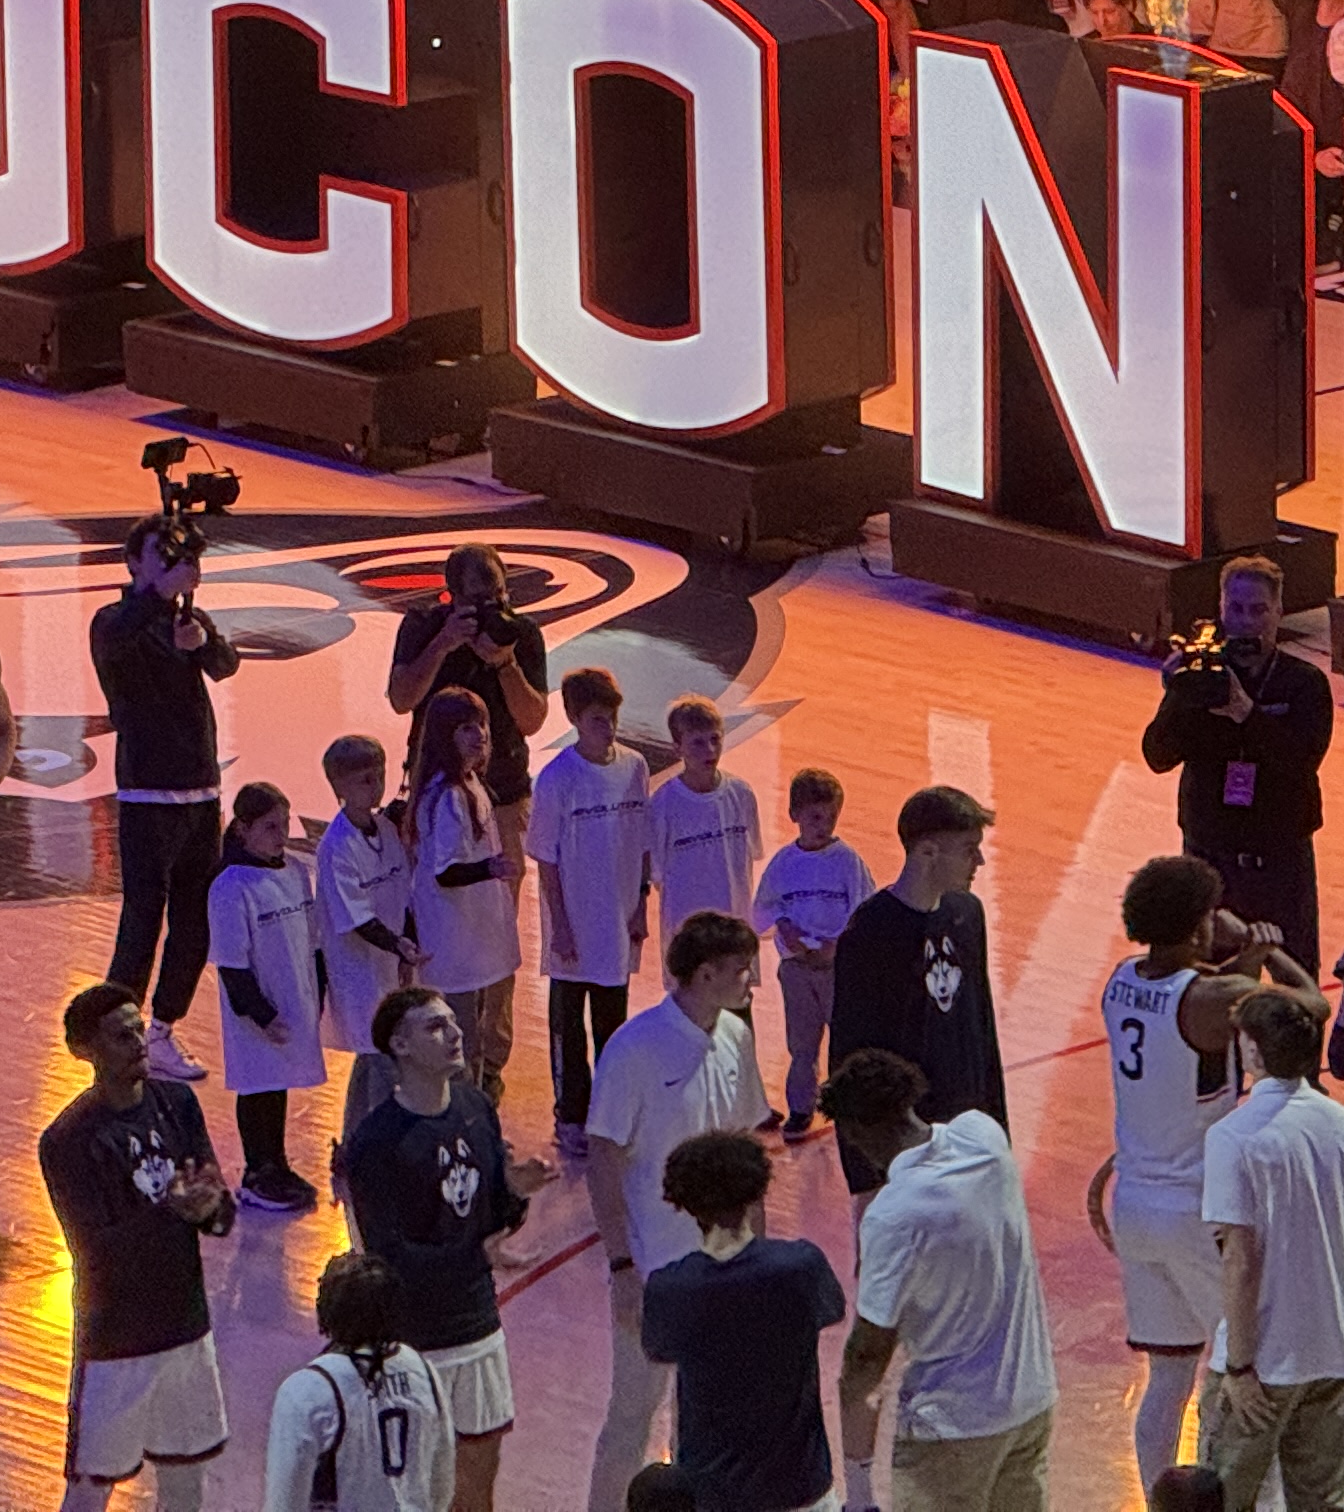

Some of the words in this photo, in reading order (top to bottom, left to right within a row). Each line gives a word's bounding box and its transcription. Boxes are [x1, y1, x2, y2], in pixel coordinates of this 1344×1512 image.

[1108, 980, 1170, 1016] STEWART
[1118, 1017, 1145, 1081] 3
[377, 1407, 409, 1477] 0
